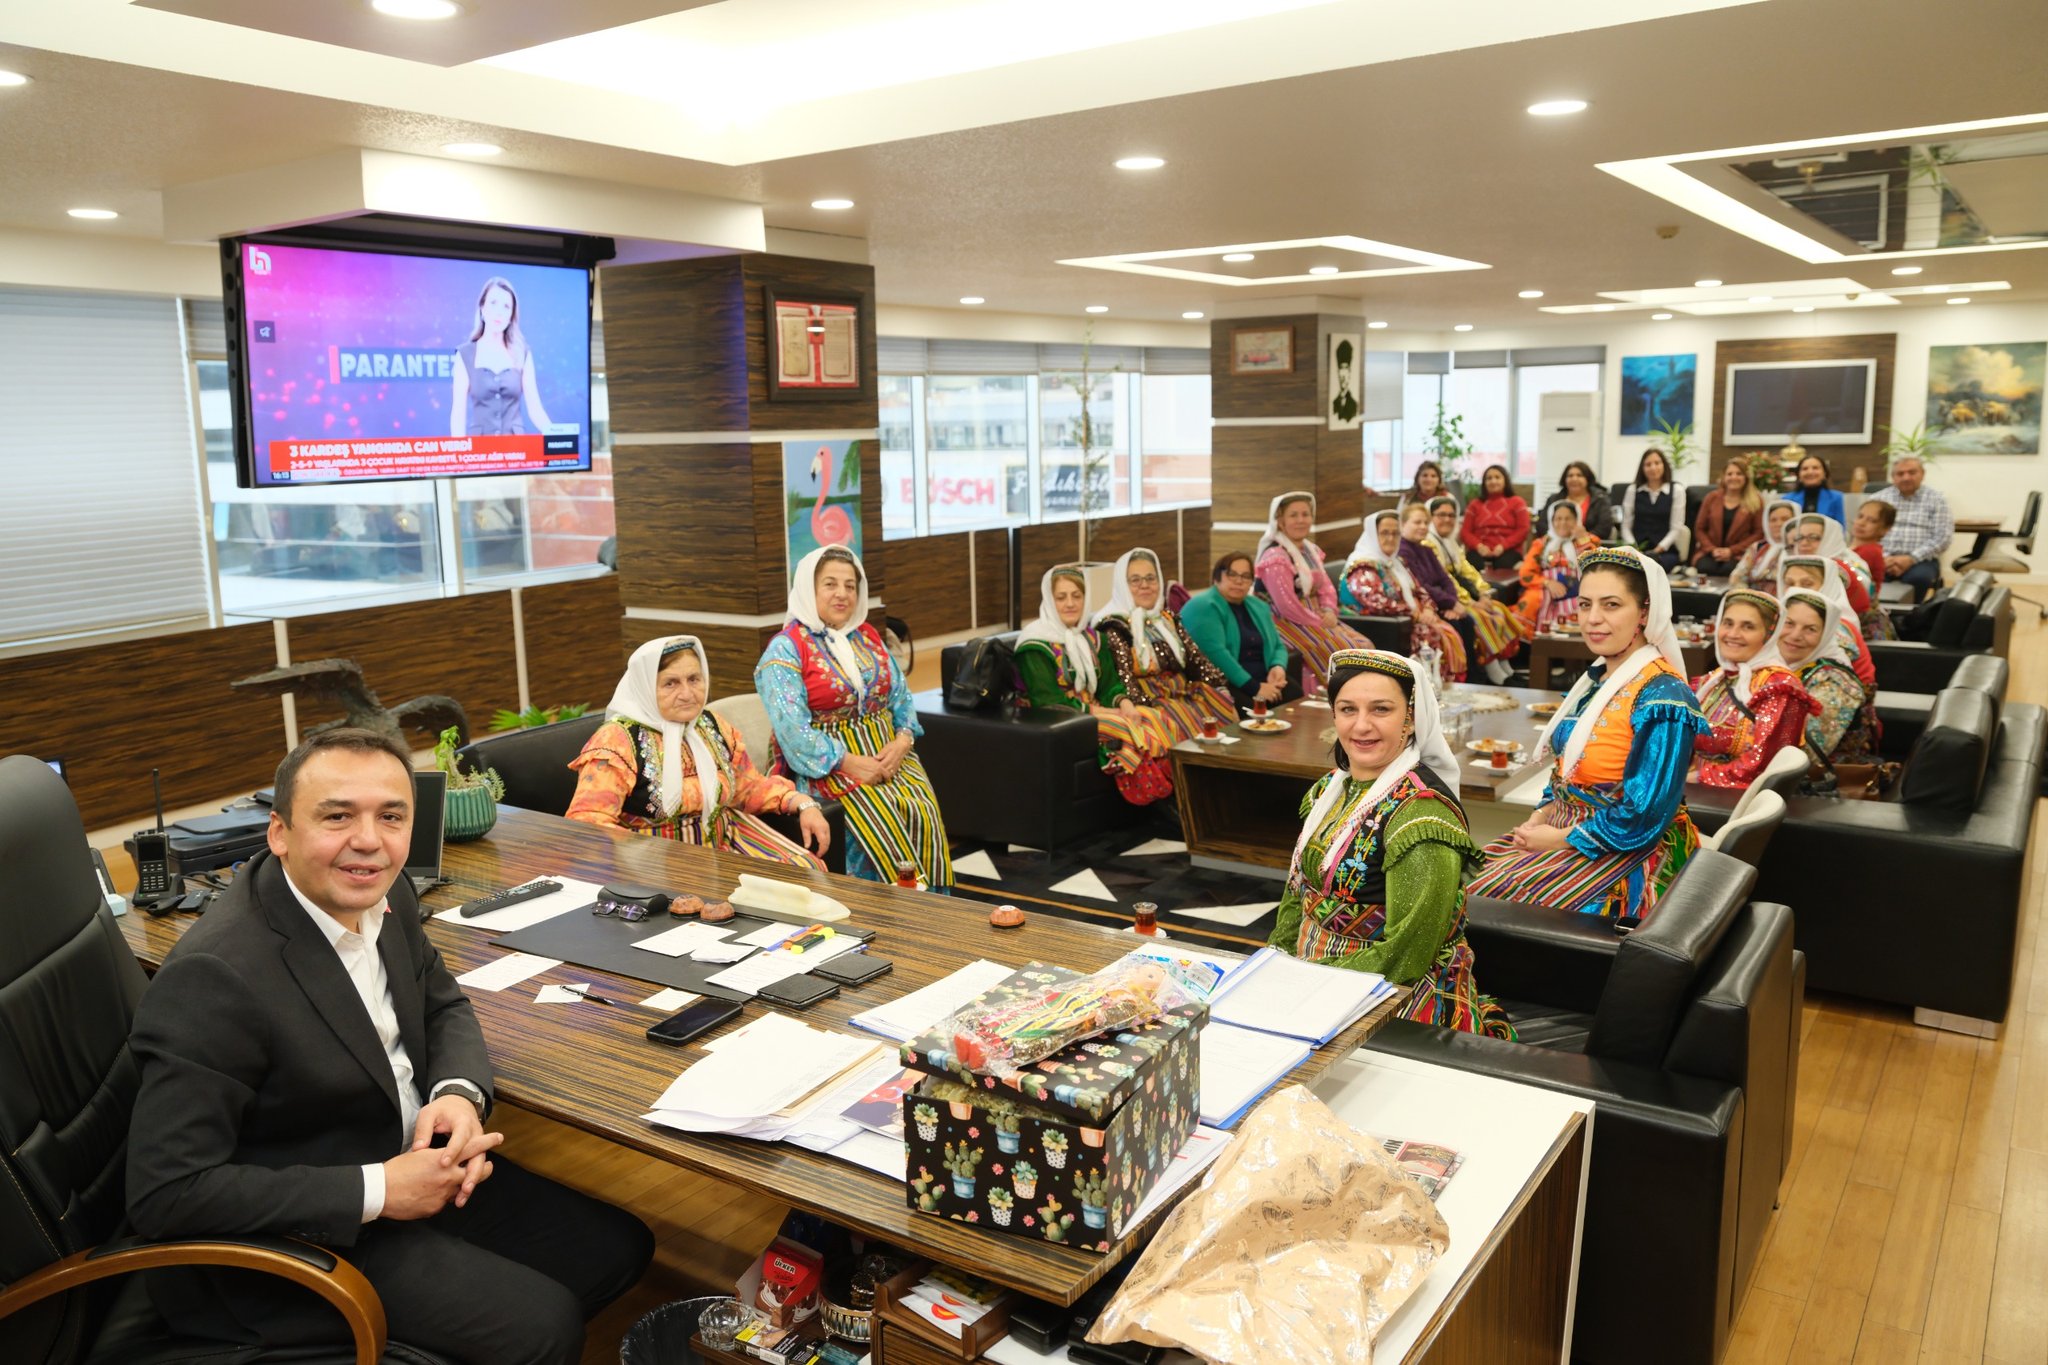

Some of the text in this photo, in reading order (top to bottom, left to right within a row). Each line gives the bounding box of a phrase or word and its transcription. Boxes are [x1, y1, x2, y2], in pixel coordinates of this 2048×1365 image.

[289, 437, 472, 458] 3 KARDEŞ YANGINDA CAN VERDİ
